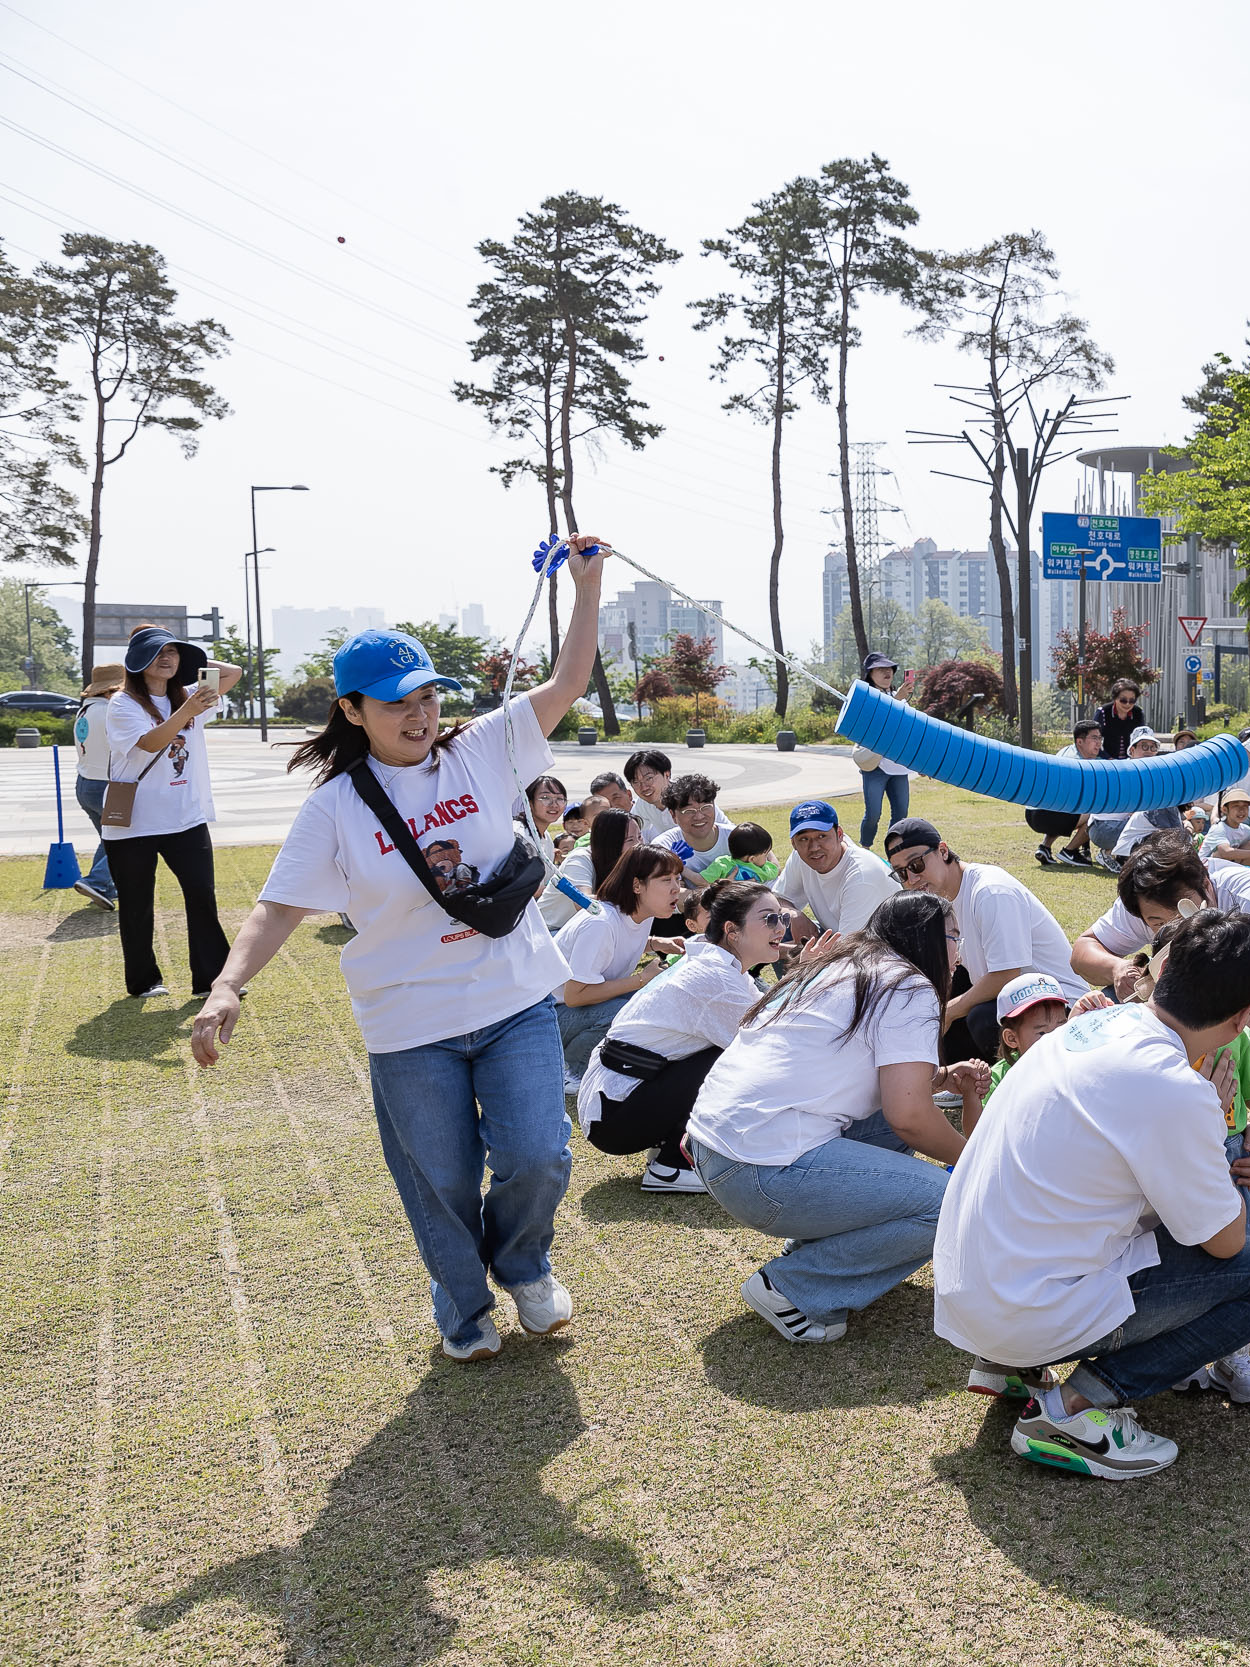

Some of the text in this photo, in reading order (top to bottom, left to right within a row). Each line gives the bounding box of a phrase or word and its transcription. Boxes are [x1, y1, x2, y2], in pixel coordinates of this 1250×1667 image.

[1092, 518, 1118, 529] 천호대교
[1088, 530, 1121, 541] 천호대로
[1052, 545, 1075, 555] 아차산
[1047, 558, 1081, 570] 워커힐로
[1128, 562, 1160, 573] 워커힐로
[1009, 984, 1059, 1005] DODGERS
